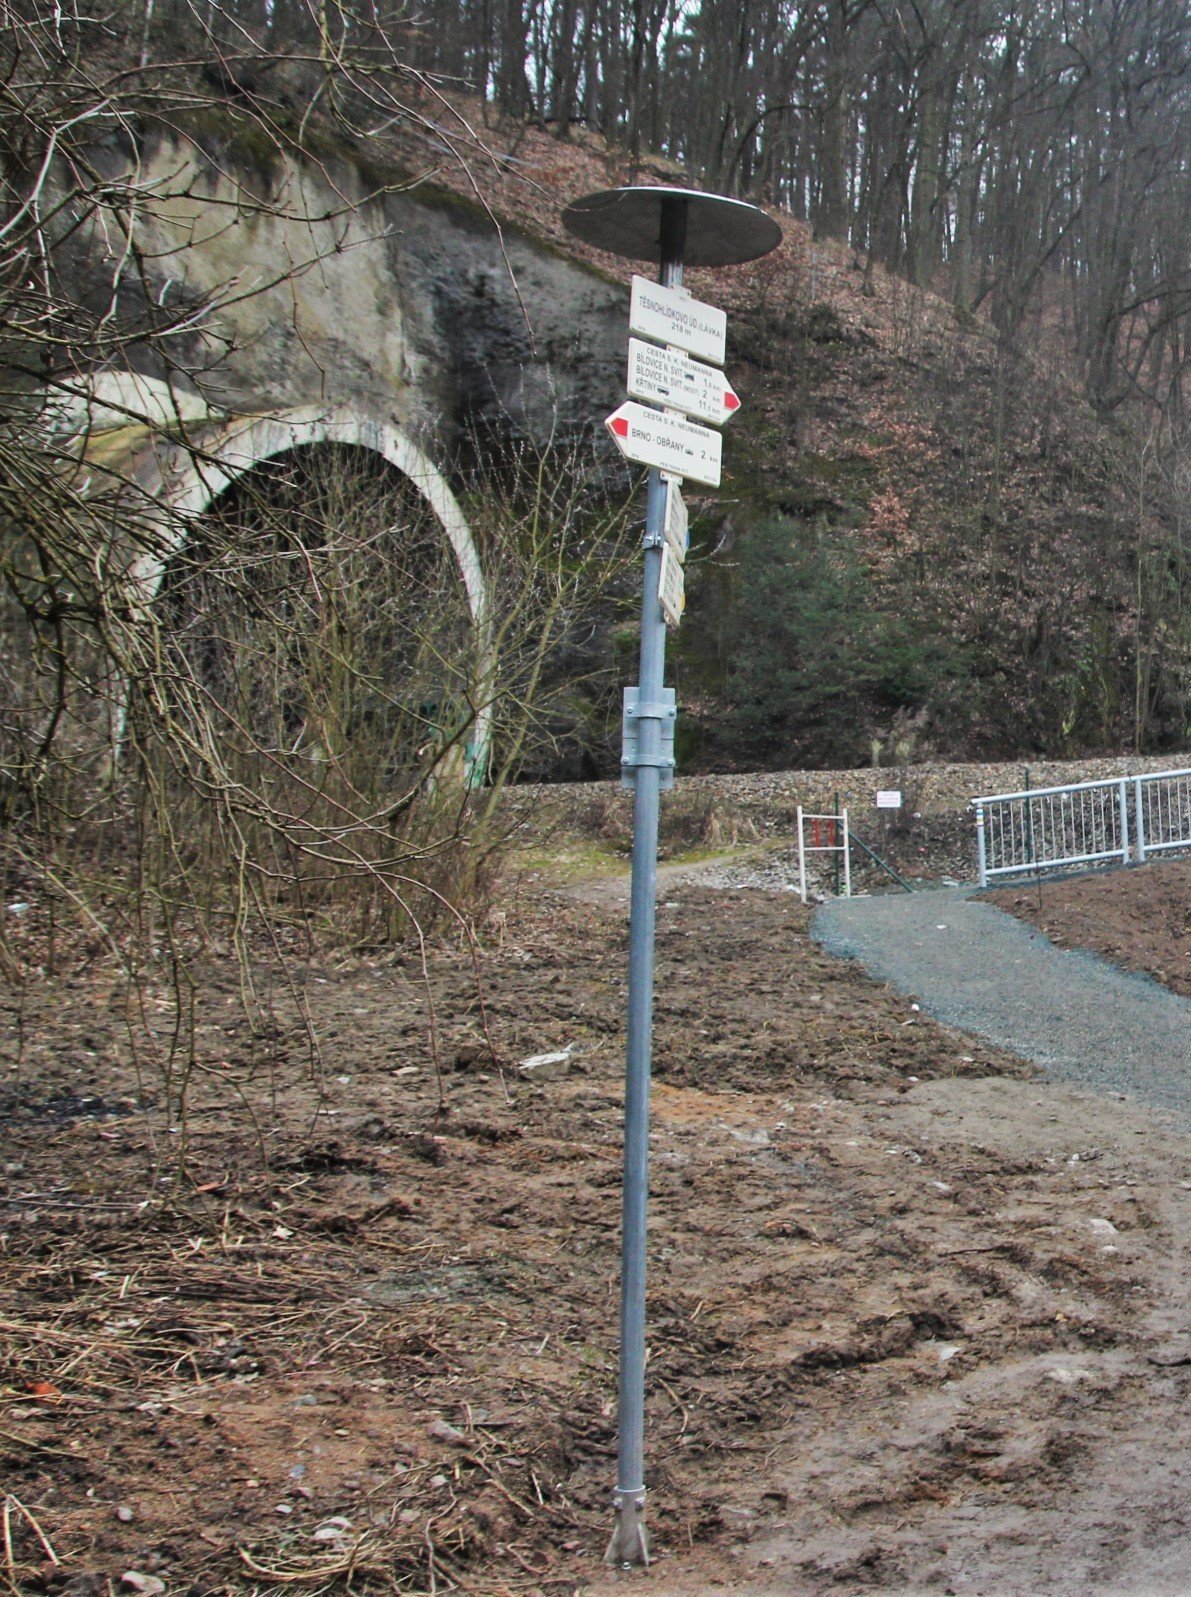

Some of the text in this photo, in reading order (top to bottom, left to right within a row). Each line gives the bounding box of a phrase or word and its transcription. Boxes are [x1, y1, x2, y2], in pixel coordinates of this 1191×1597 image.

[639, 295, 688, 324] TĚSNOHLÍDKOVO
[671, 322, 684, 332] 218
[636, 352, 663, 370] BÍLOVICE
[647, 348, 666, 359] CESTA
[681, 360, 713, 377] NEUMANNA
[636, 363, 662, 382] BÍLOVICE
[702, 390, 708, 398] 2
[635, 377, 657, 391] KŘTINY
[712, 406, 720, 414] km
[643, 411, 662, 423] CESTA
[678, 422, 710, 438] NEUMANNA
[631, 428, 651, 442] BRNO
[656, 436, 684, 453] OBŘANY
[701, 450, 706, 460] 2
